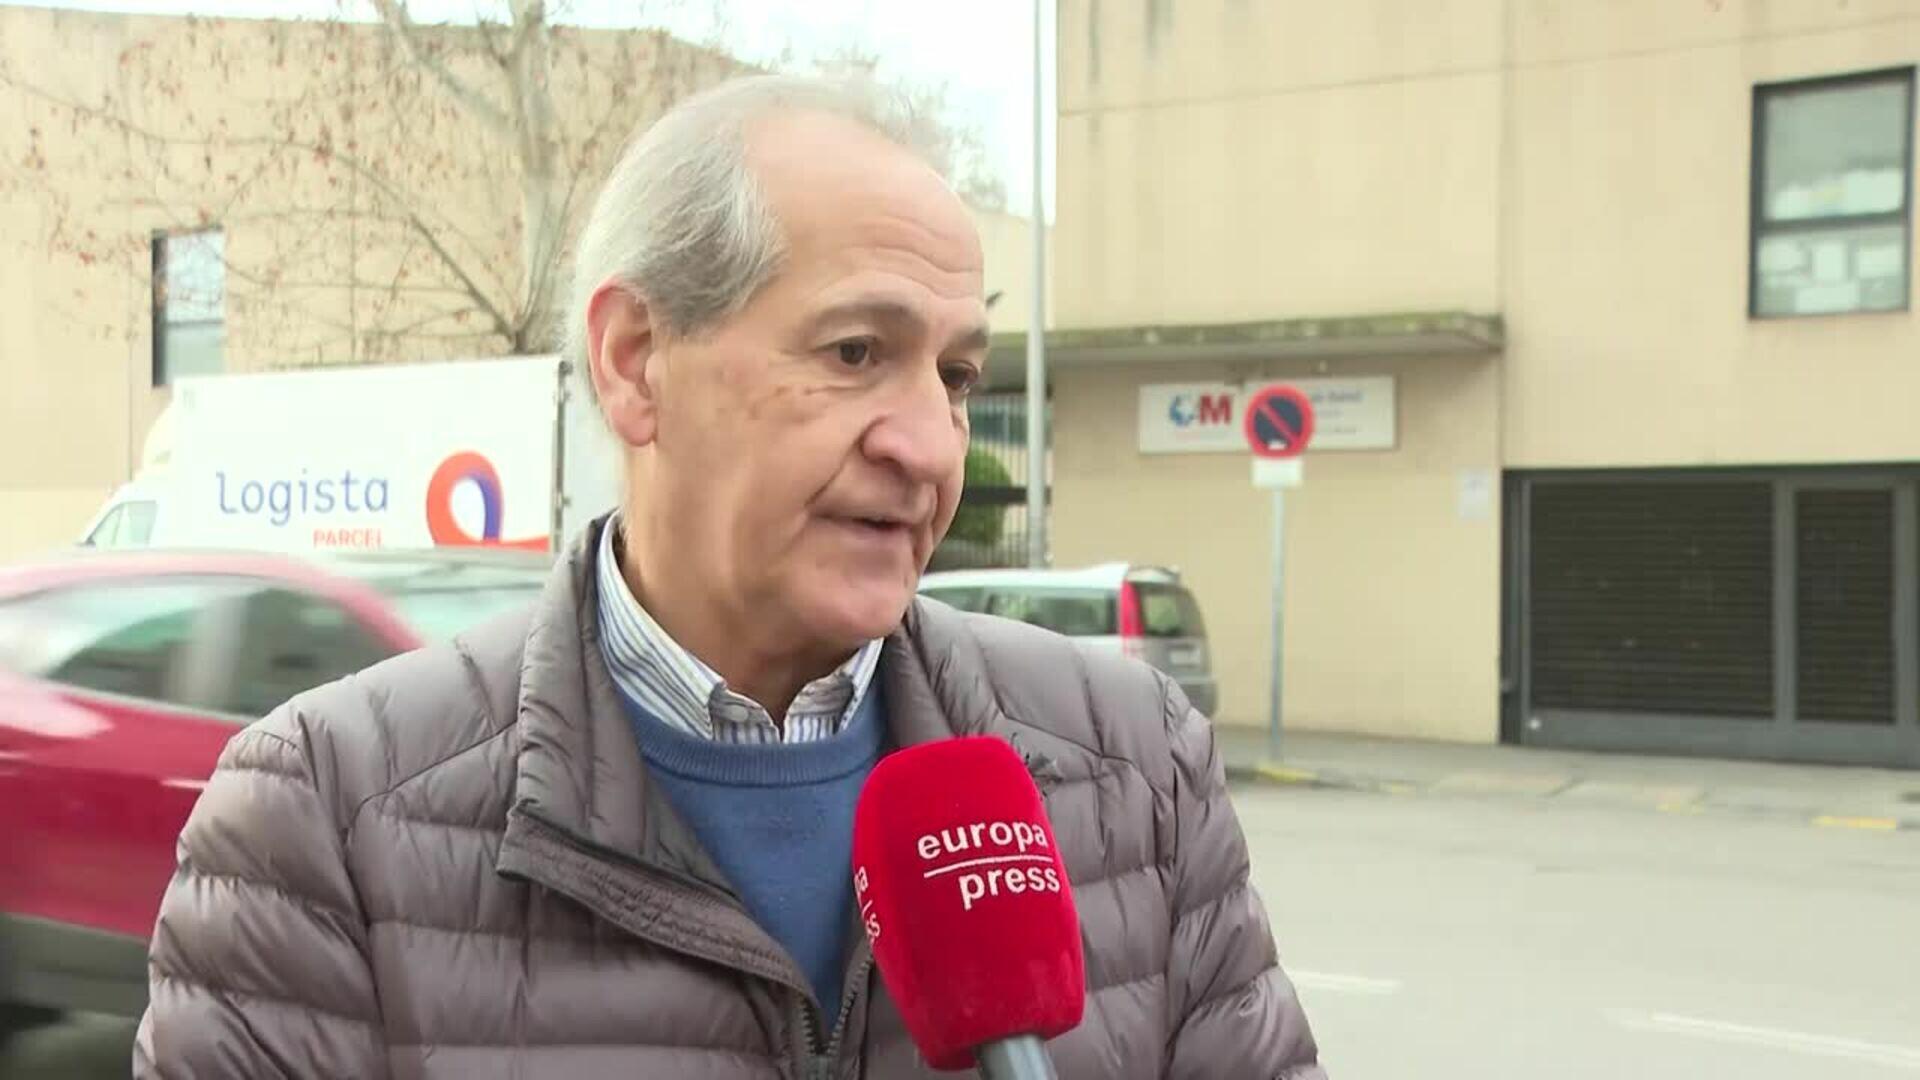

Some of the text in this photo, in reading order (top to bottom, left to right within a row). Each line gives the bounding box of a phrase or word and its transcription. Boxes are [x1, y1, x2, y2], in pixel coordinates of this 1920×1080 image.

[216, 469, 389, 527] logista
[312, 528, 383, 549] PARCEL
[917, 821, 1049, 860] europa
[958, 866, 1060, 911] press
